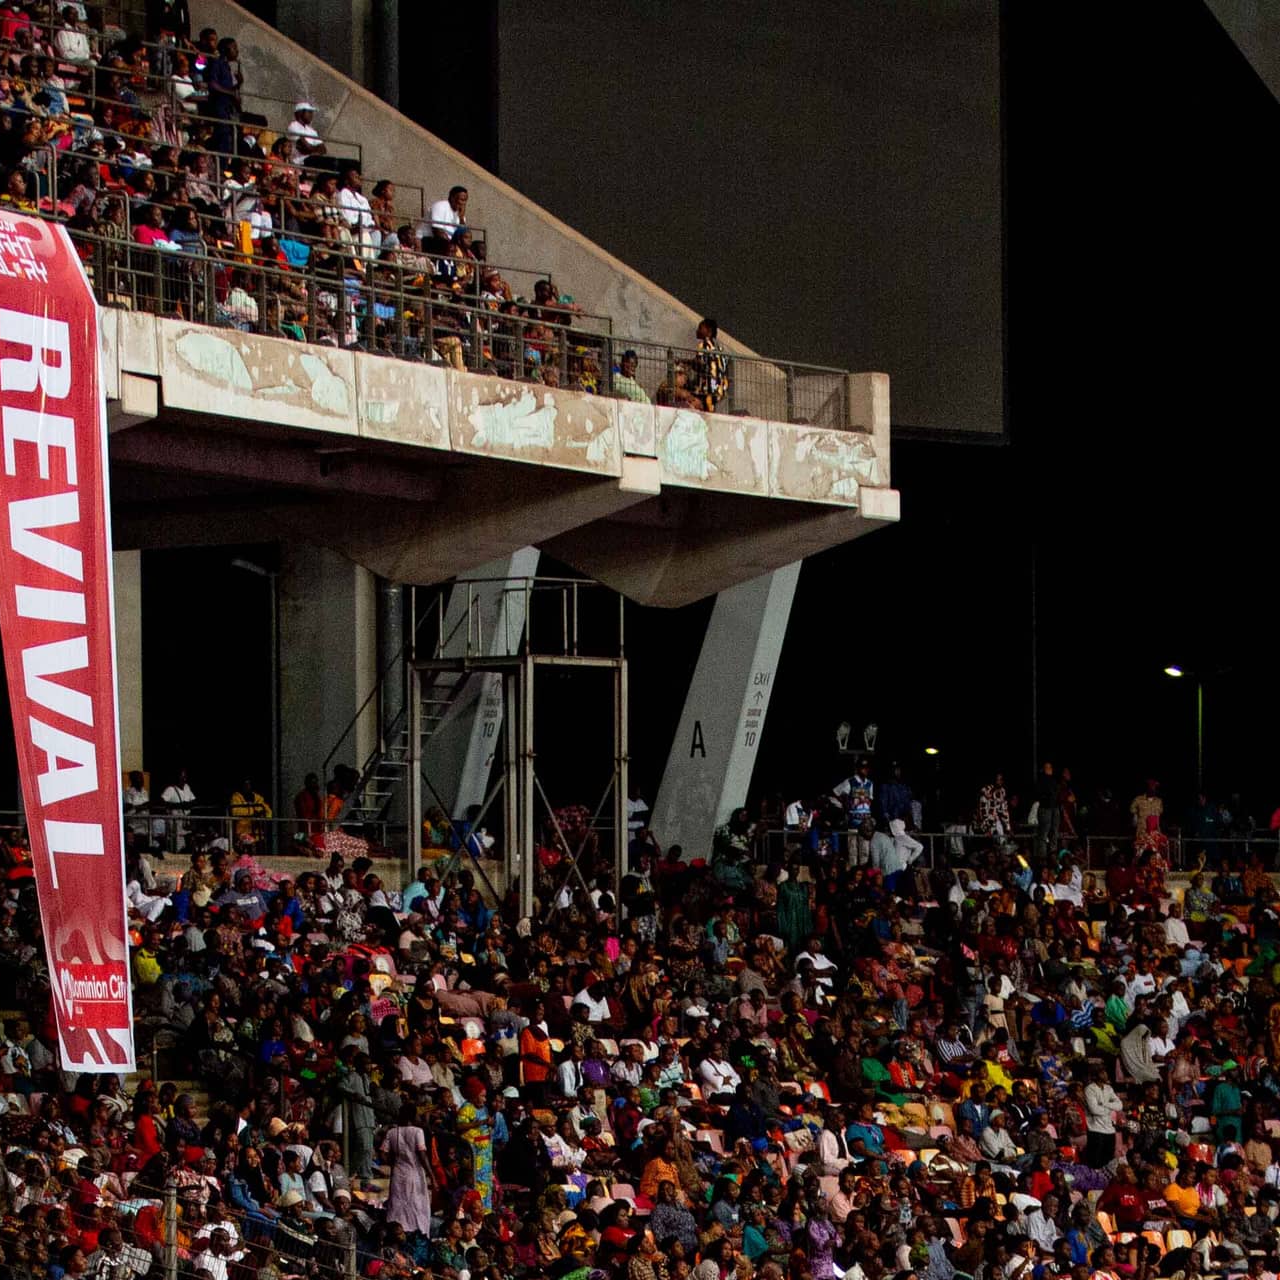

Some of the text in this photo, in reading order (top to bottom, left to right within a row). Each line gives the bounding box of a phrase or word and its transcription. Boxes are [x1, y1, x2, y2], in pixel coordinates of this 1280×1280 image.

[482, 722, 496, 738] 10
[689, 720, 706, 758] A
[744, 731, 756, 747] 10
